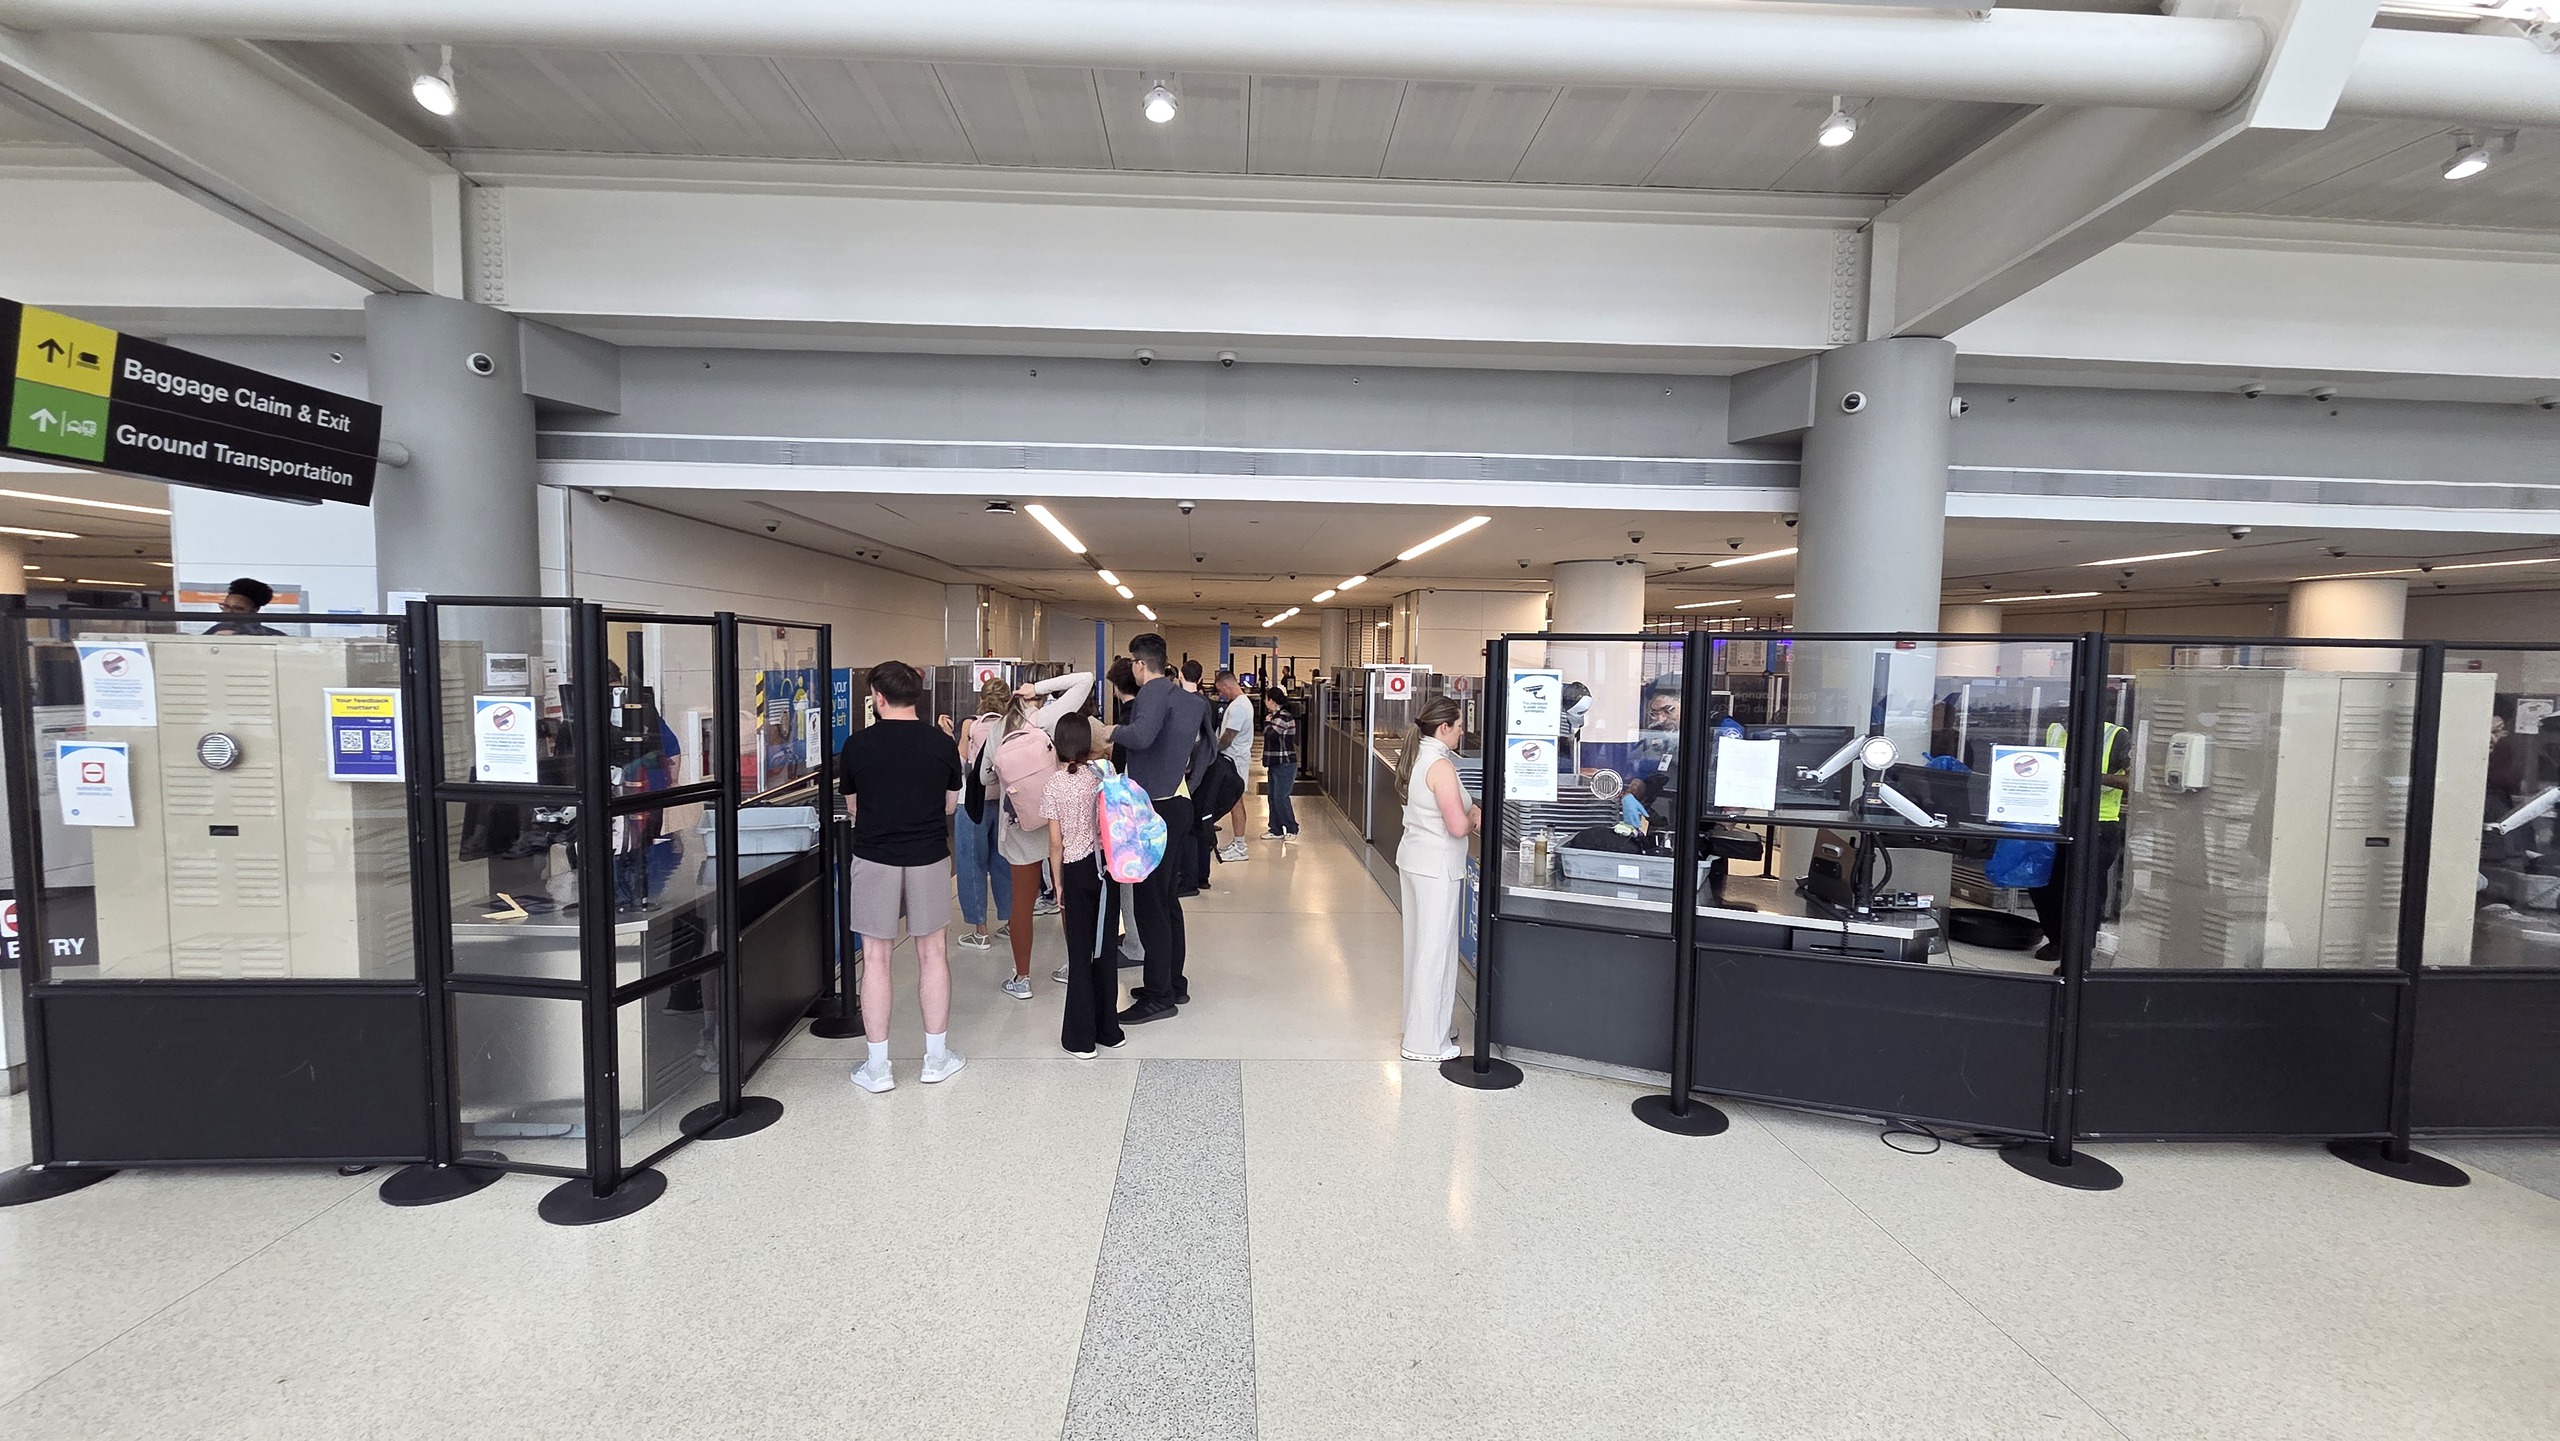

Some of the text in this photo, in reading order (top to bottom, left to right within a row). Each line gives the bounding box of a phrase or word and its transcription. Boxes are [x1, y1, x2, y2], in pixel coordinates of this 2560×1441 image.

[123, 357, 351, 433] Baggage Claim & Exit
[116, 424, 353, 487] Ground Transportation
[833, 682, 847, 695] your
[837, 696, 847, 709] bin
[836, 712, 847, 727] left
